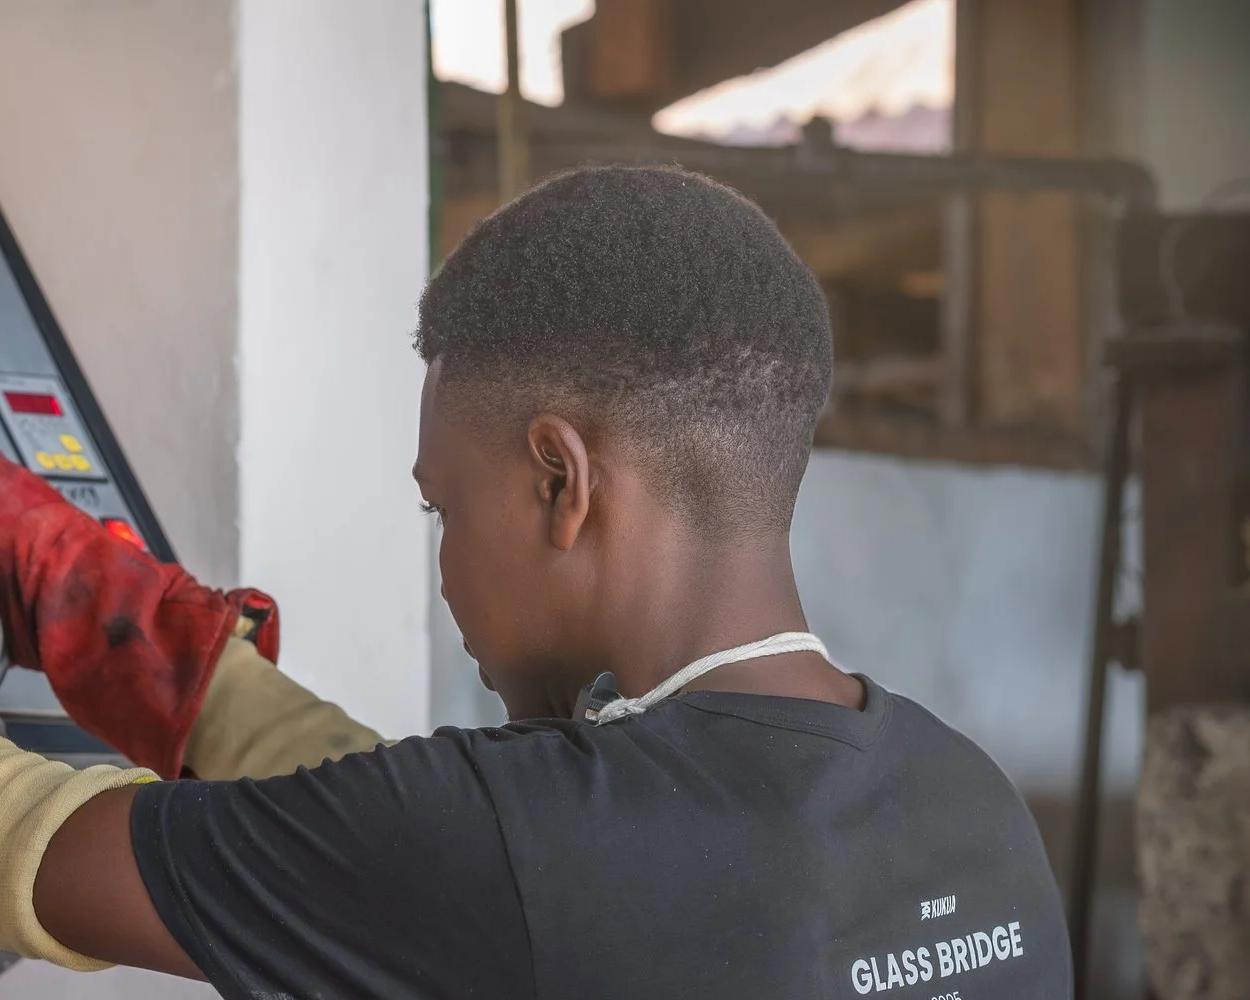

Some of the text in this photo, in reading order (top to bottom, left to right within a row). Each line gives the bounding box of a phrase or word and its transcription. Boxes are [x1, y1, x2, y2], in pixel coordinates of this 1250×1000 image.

[931, 895, 956, 918] KUKUA
[851, 921, 1024, 995] GLASS BRIDGE
